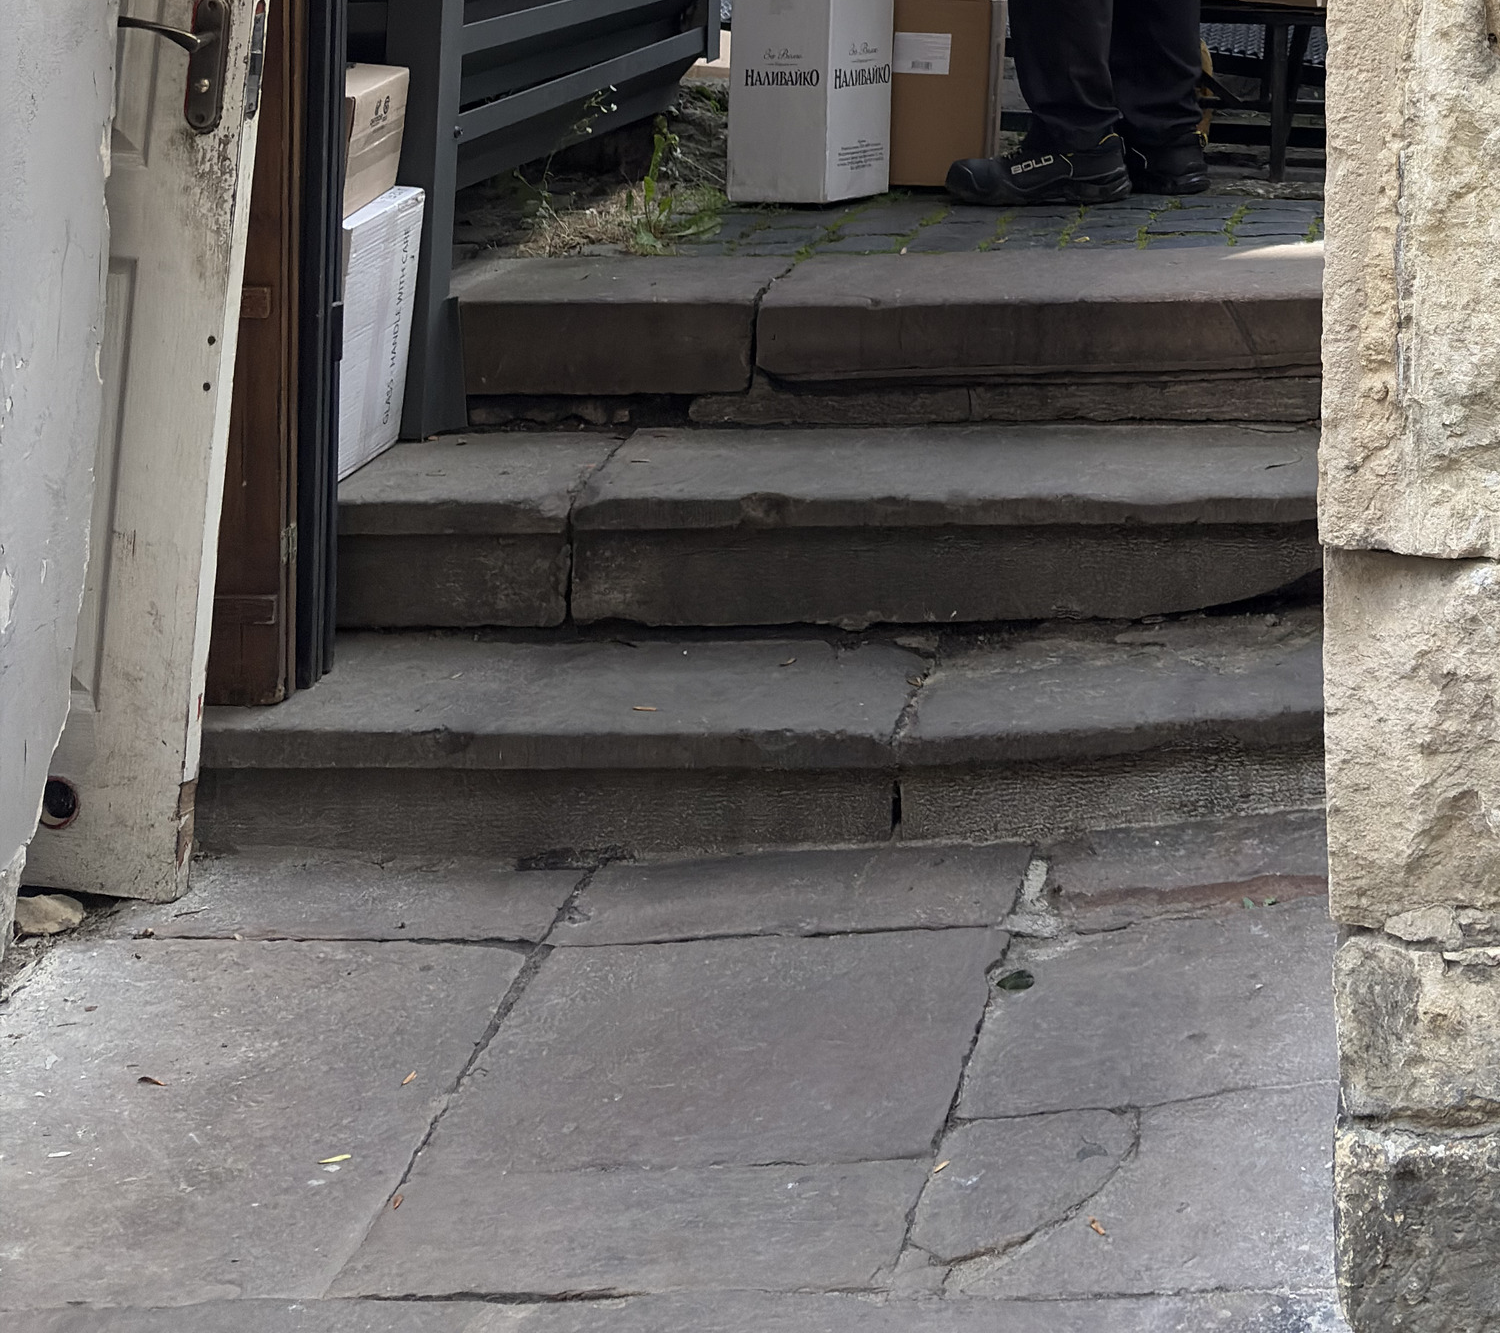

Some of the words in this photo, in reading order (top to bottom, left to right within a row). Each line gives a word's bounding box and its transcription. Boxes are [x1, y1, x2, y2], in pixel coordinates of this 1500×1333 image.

[1010, 154, 1054, 175] BOLD
[389, 307, 402, 368] HANDLE
[396, 268, 406, 306] WITH
